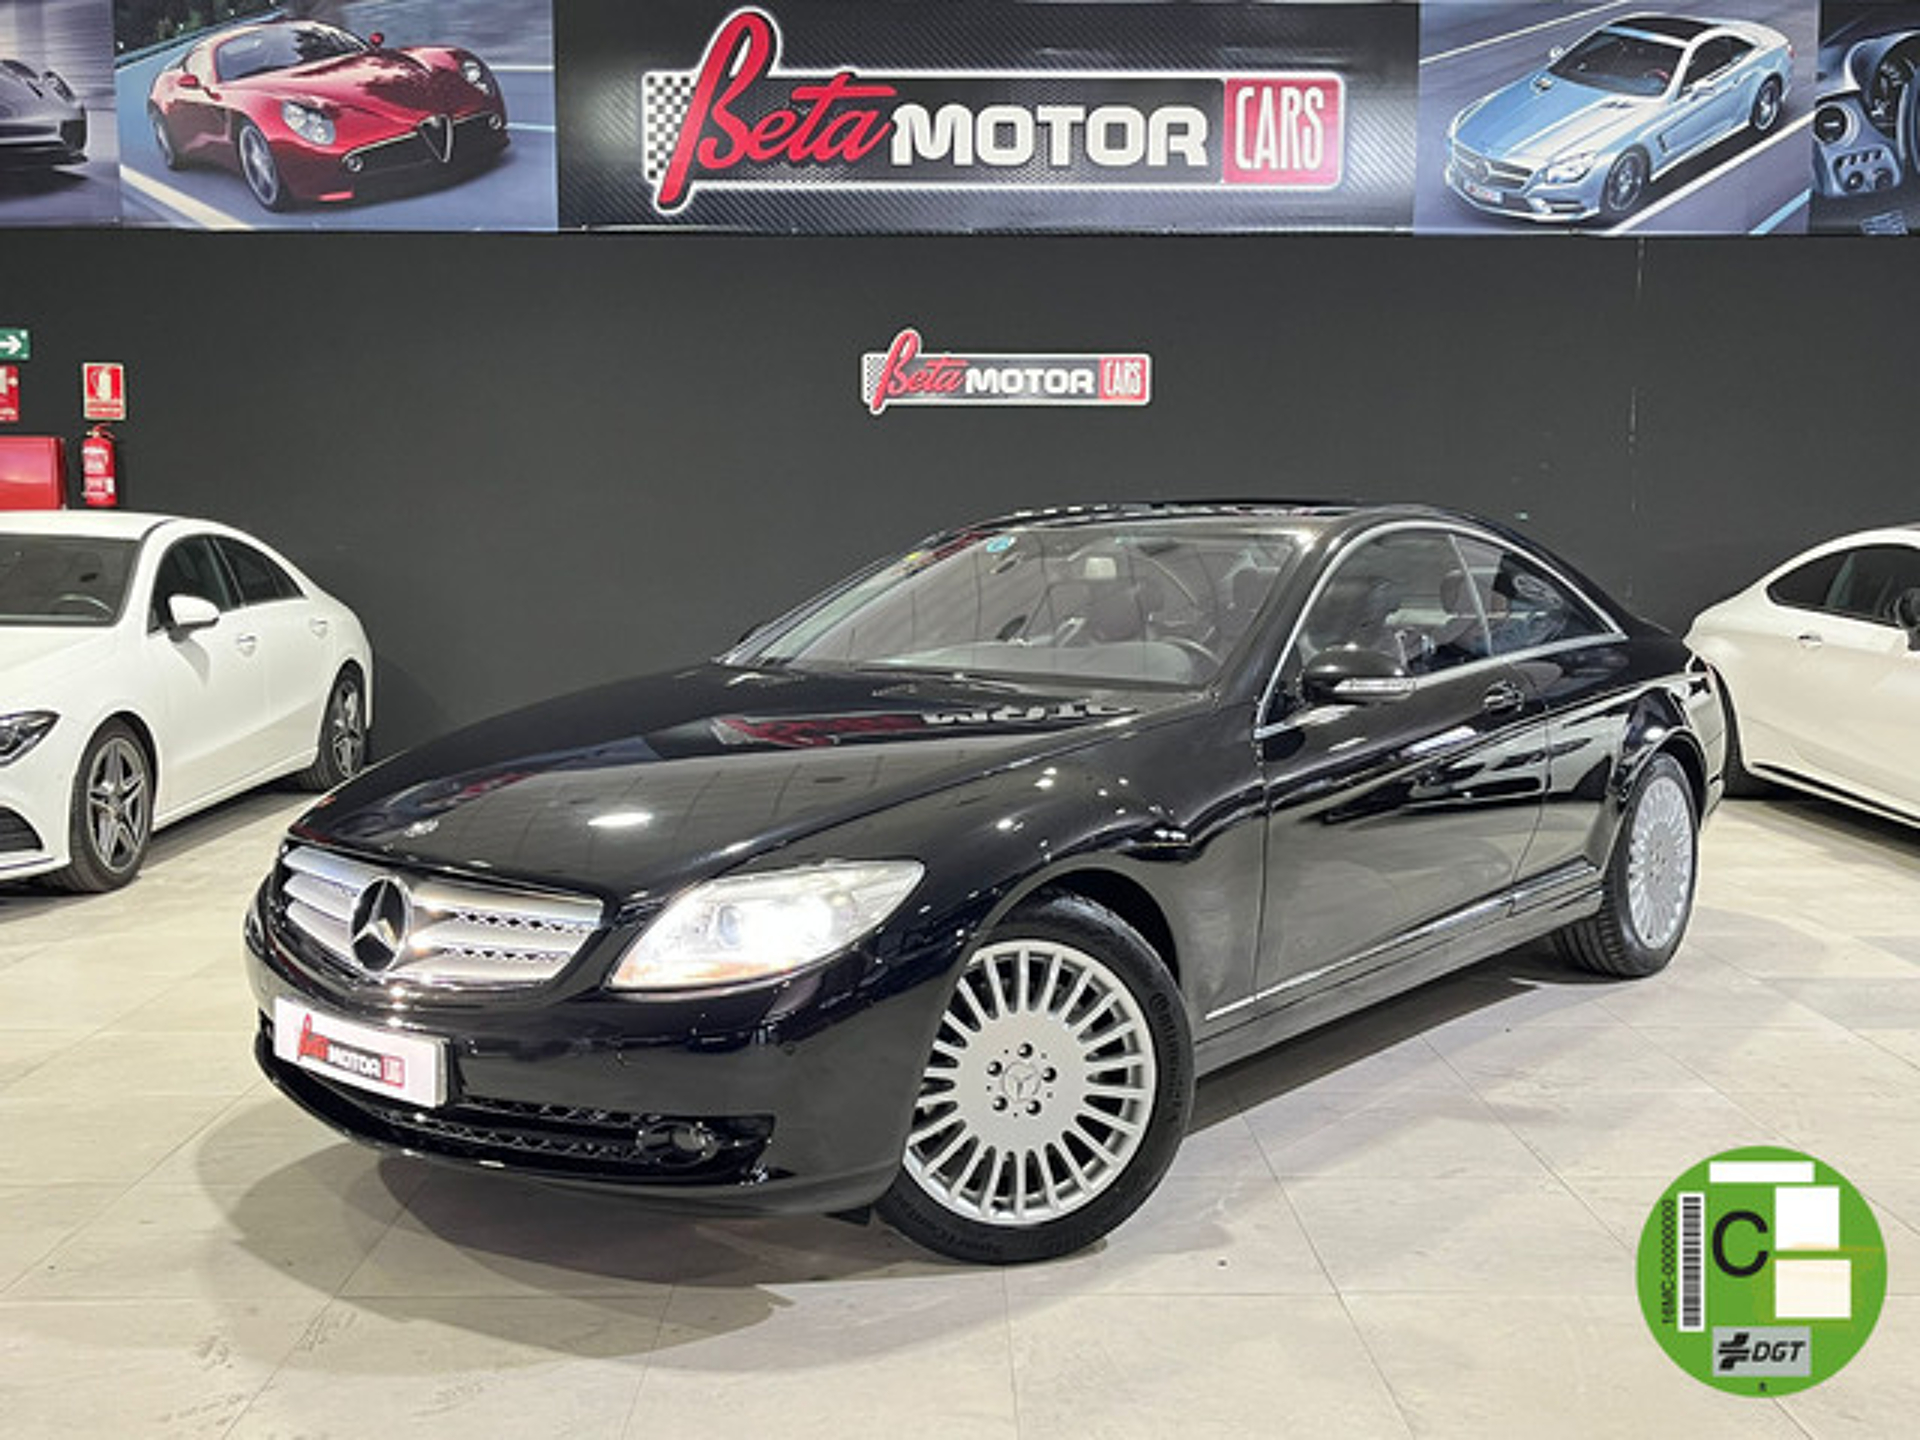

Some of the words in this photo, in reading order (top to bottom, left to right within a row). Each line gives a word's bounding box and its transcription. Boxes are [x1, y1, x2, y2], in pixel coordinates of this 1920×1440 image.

[659, 12, 897, 204] Beta
[891, 103, 1209, 166] MOTOR
[1235, 86, 1324, 170] CARS
[872, 331, 968, 410] Beta
[965, 368, 1094, 394] MOTOR
[1104, 360, 1142, 396] CARS
